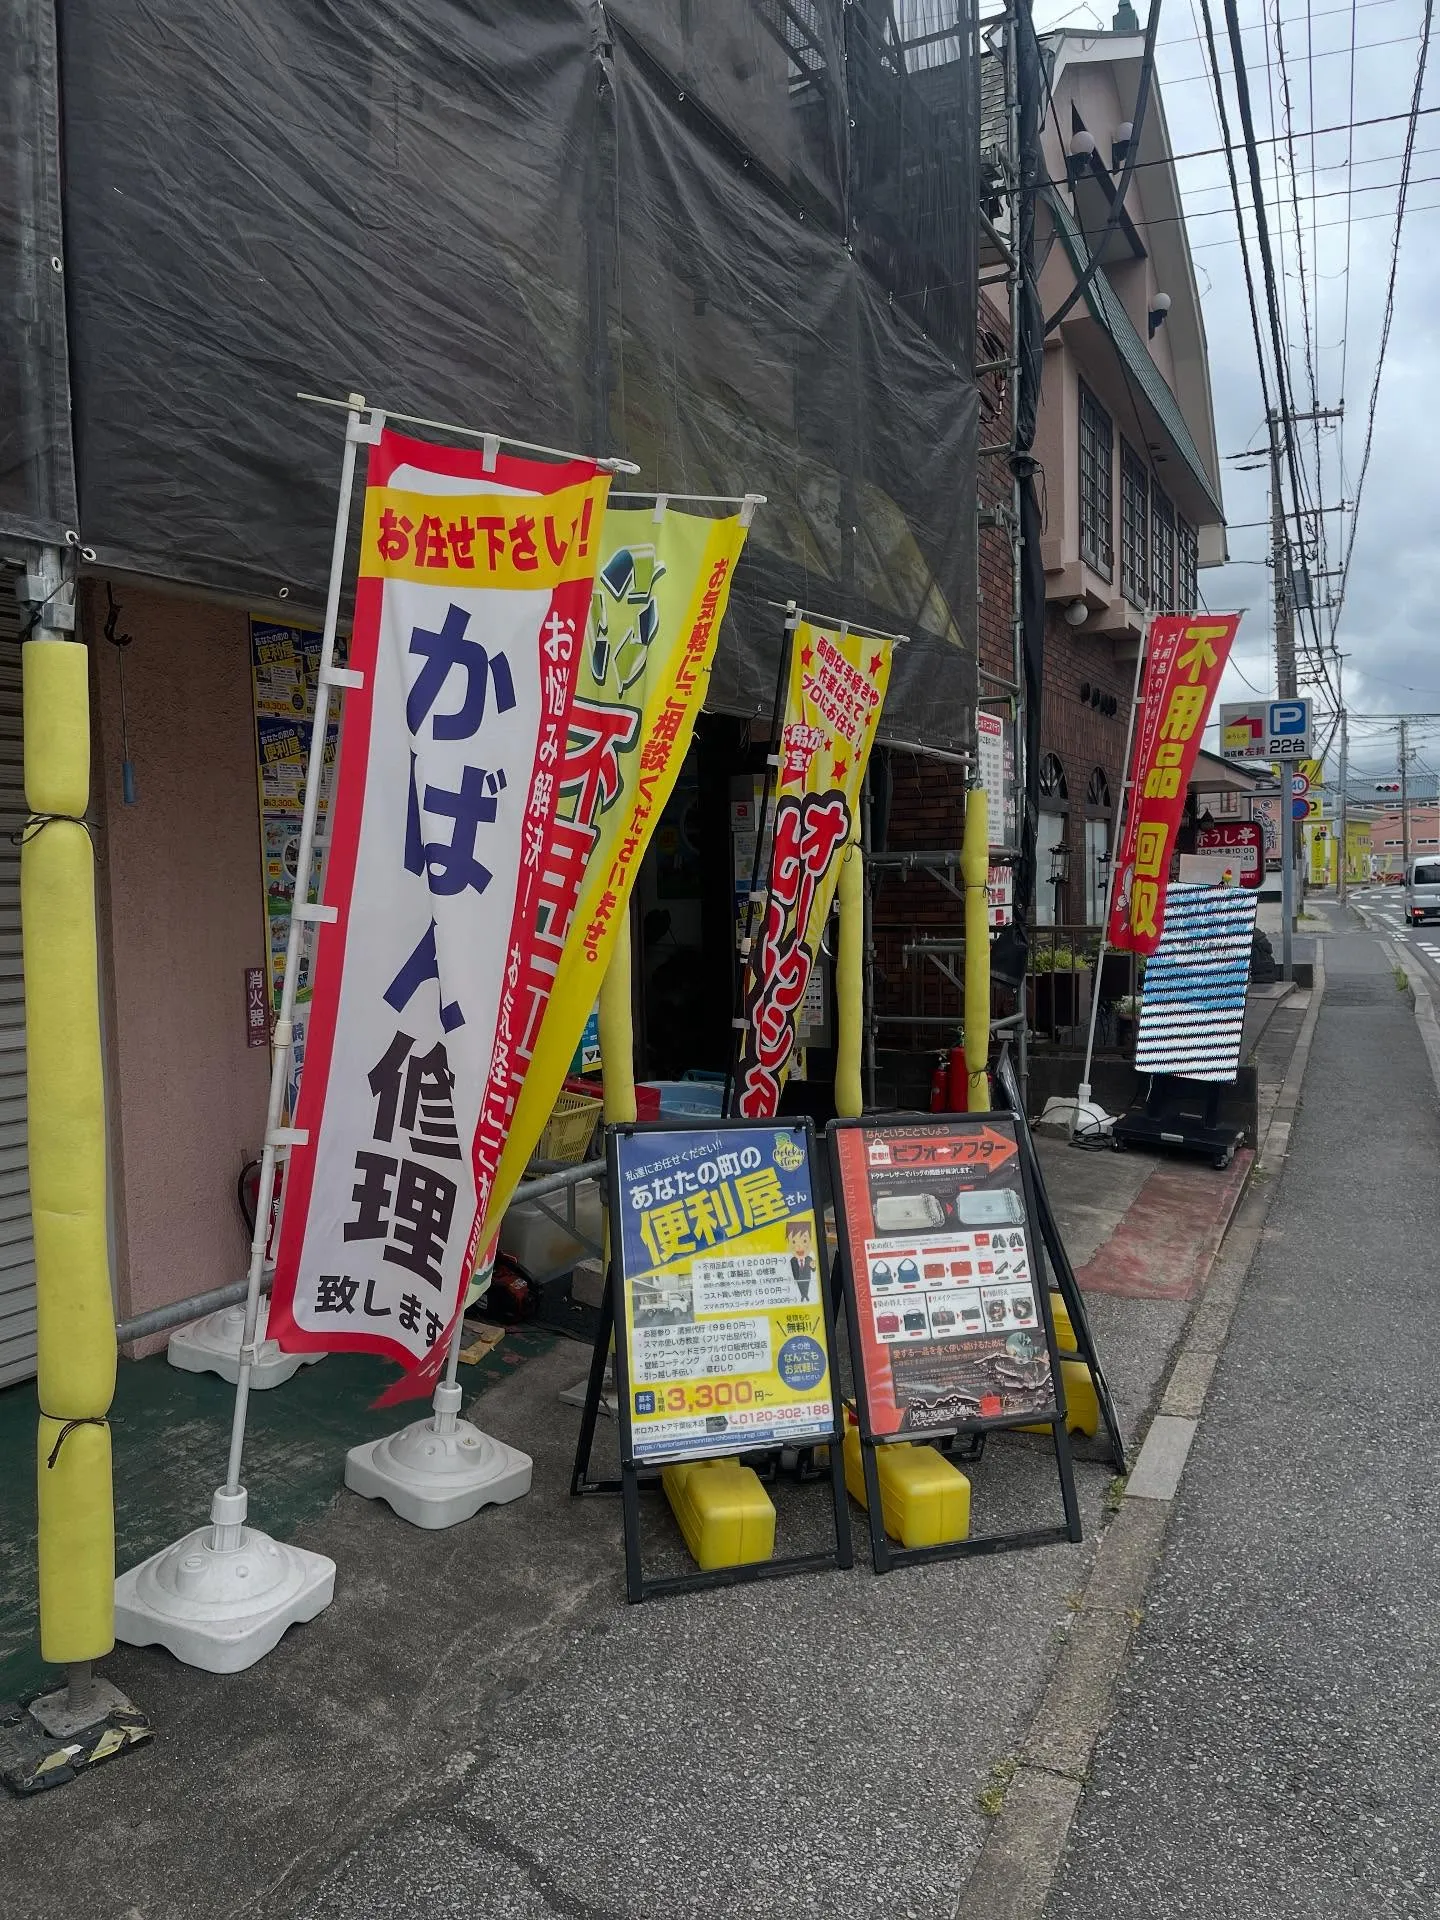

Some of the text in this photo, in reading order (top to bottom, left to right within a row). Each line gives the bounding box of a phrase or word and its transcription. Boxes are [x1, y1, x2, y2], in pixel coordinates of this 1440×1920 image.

[257, 640, 295, 663] 便利屋
[816, 637, 881, 707] 面倒な手続きや
[818, 665, 866, 722] 作業は全て
[1273, 707, 1303, 732] P
[264, 736, 301, 763] 便利屋
[1270, 738, 1306, 755] 22台
[248, 970, 265, 1028] 消火器
[866, 1127, 950, 1138] なんということでしょう
[629, 1146, 763, 1210] あなたの町の
[785, 1191, 807, 1207] さん
[639, 1166, 791, 1268] 便利屋
[314, 1275, 445, 1348] 致します
[784, 1351, 819, 1362] なんでも
[790, 1343, 811, 1351] その他
[784, 1363, 820, 1375] お気軽に
[739, 1403, 830, 1425] 0120-302-188
